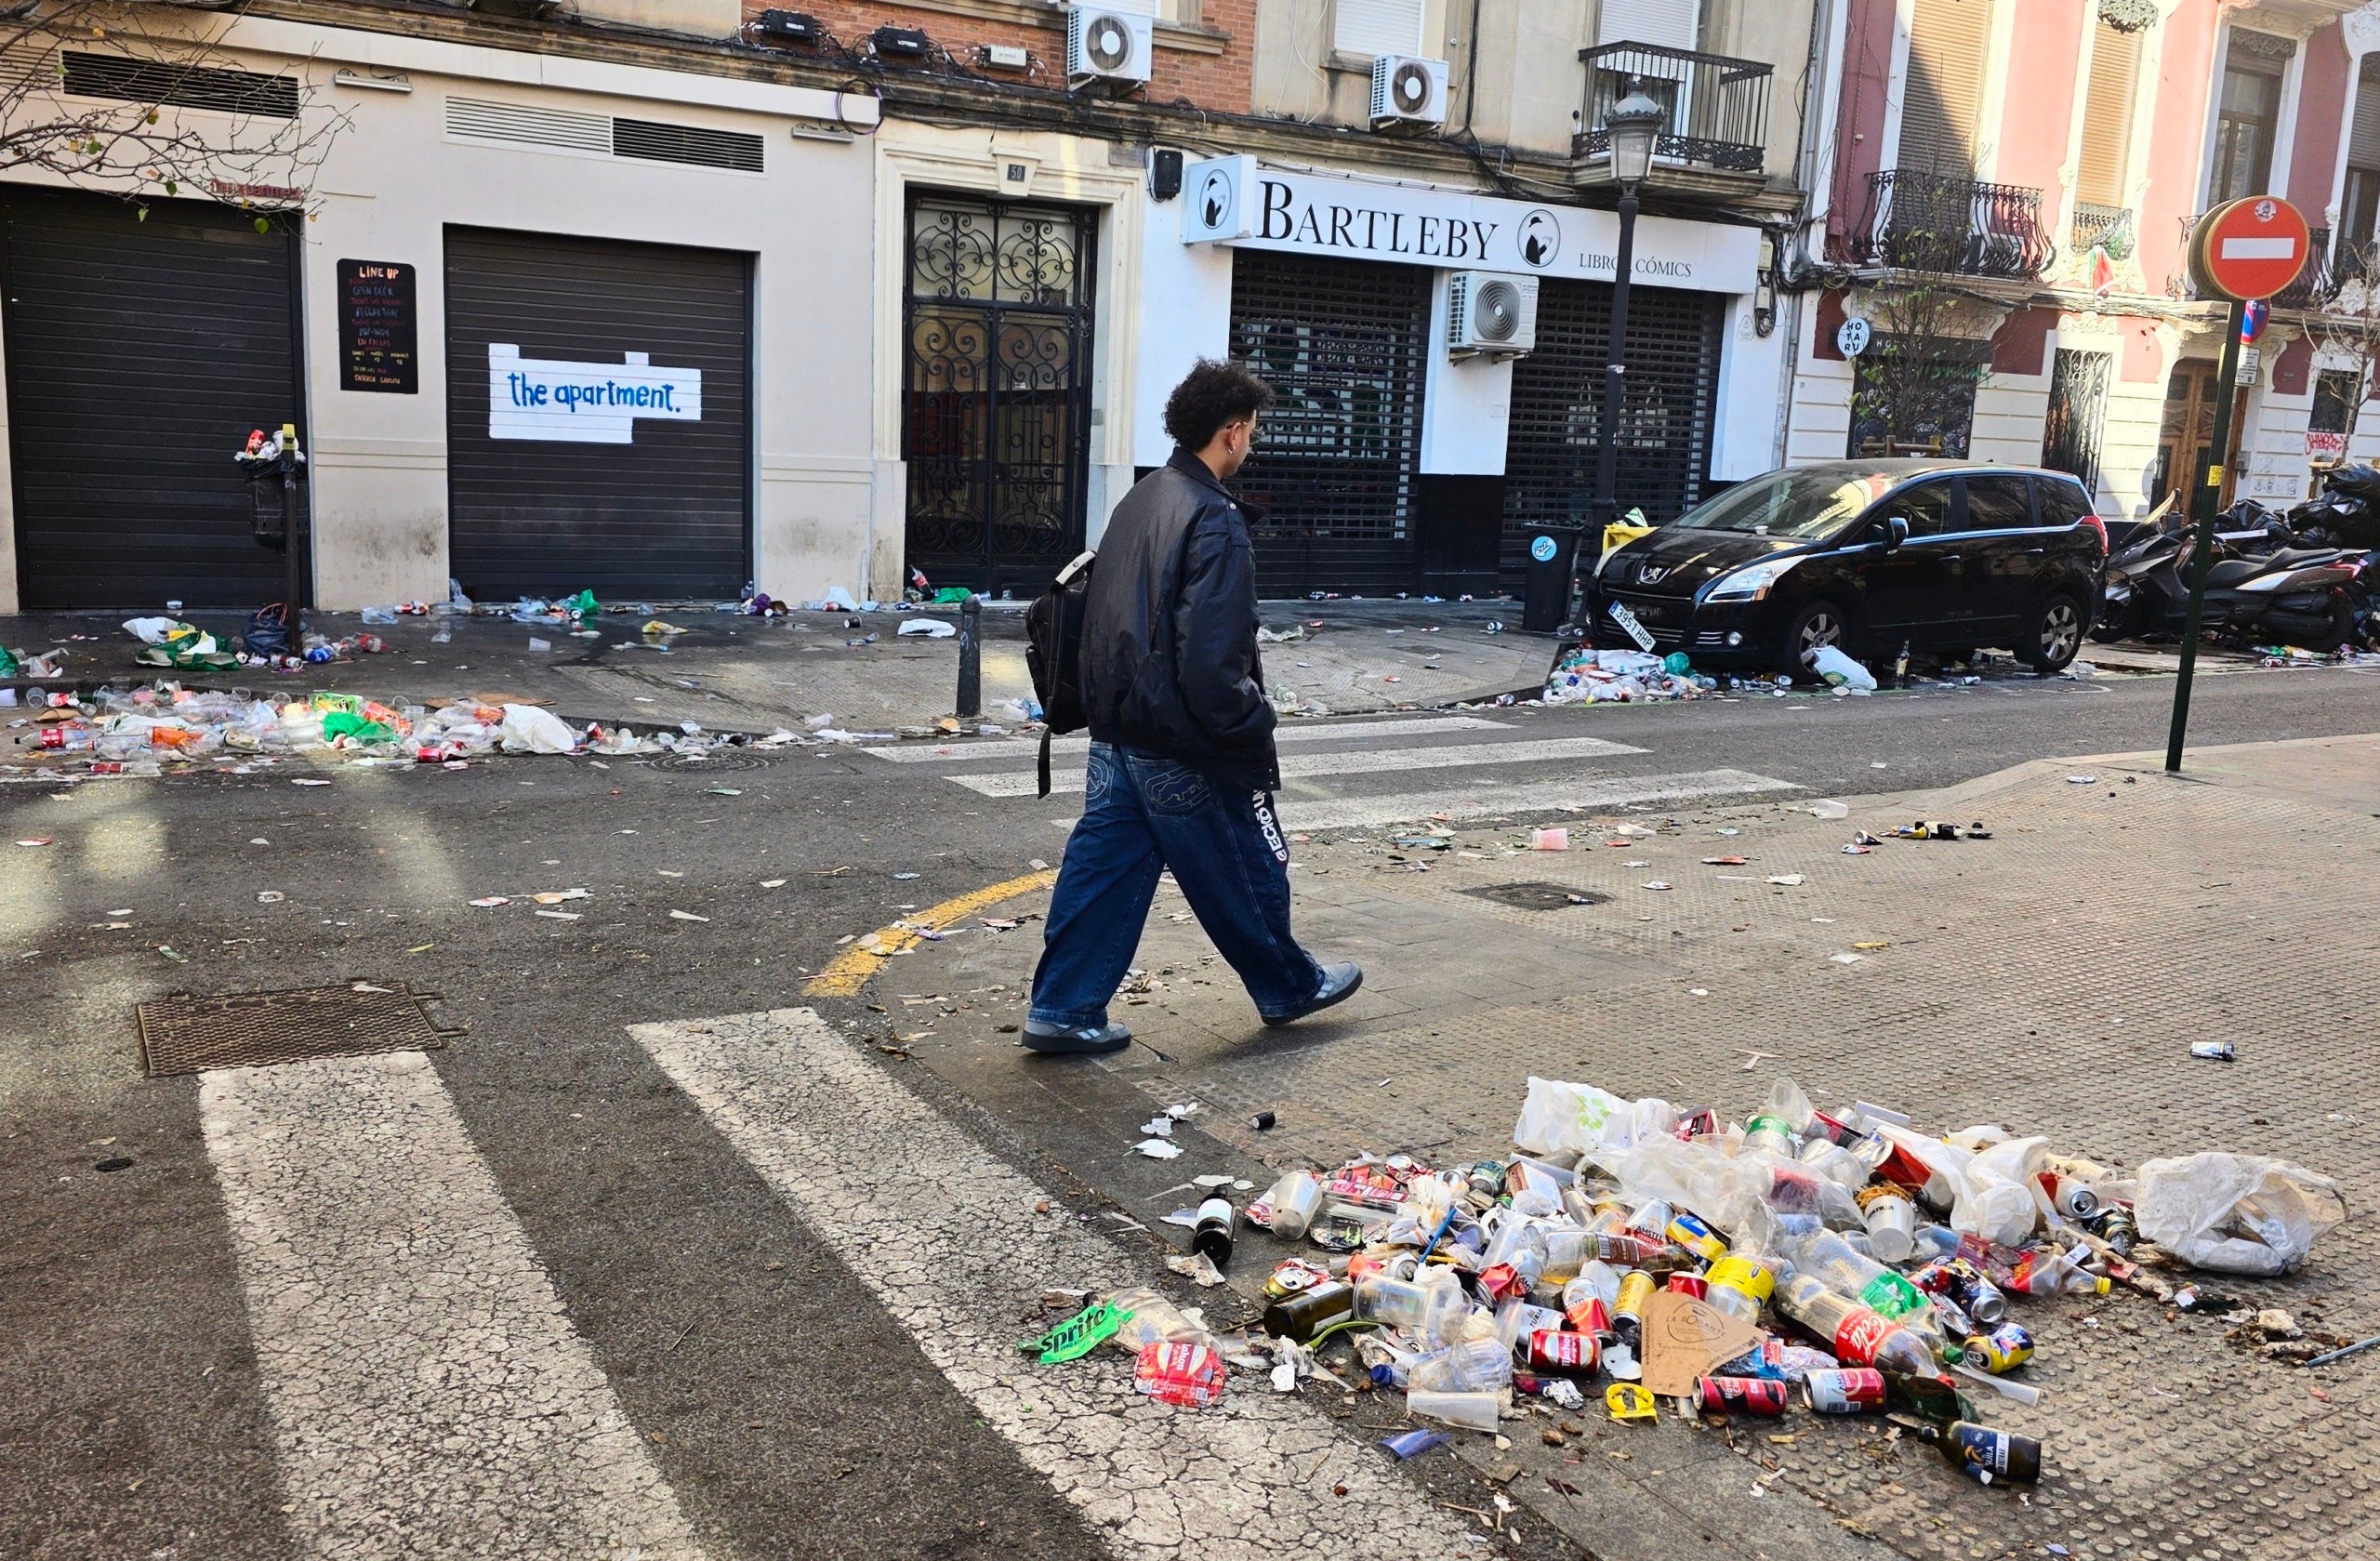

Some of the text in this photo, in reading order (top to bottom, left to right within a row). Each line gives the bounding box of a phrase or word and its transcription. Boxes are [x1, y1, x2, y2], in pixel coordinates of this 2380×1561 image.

[1011, 165, 1023, 179] 50
[1255, 179, 1499, 262] BARTLEBY
[359, 265, 400, 280] LINE UP
[1635, 256, 1692, 278] CÓMICS
[507, 372, 681, 414] the apartment.
[1615, 606, 1654, 649] 3951 HHP
[1529, 1308, 1544, 1328] TURIA
[1848, 1314, 1885, 1359] Cola
